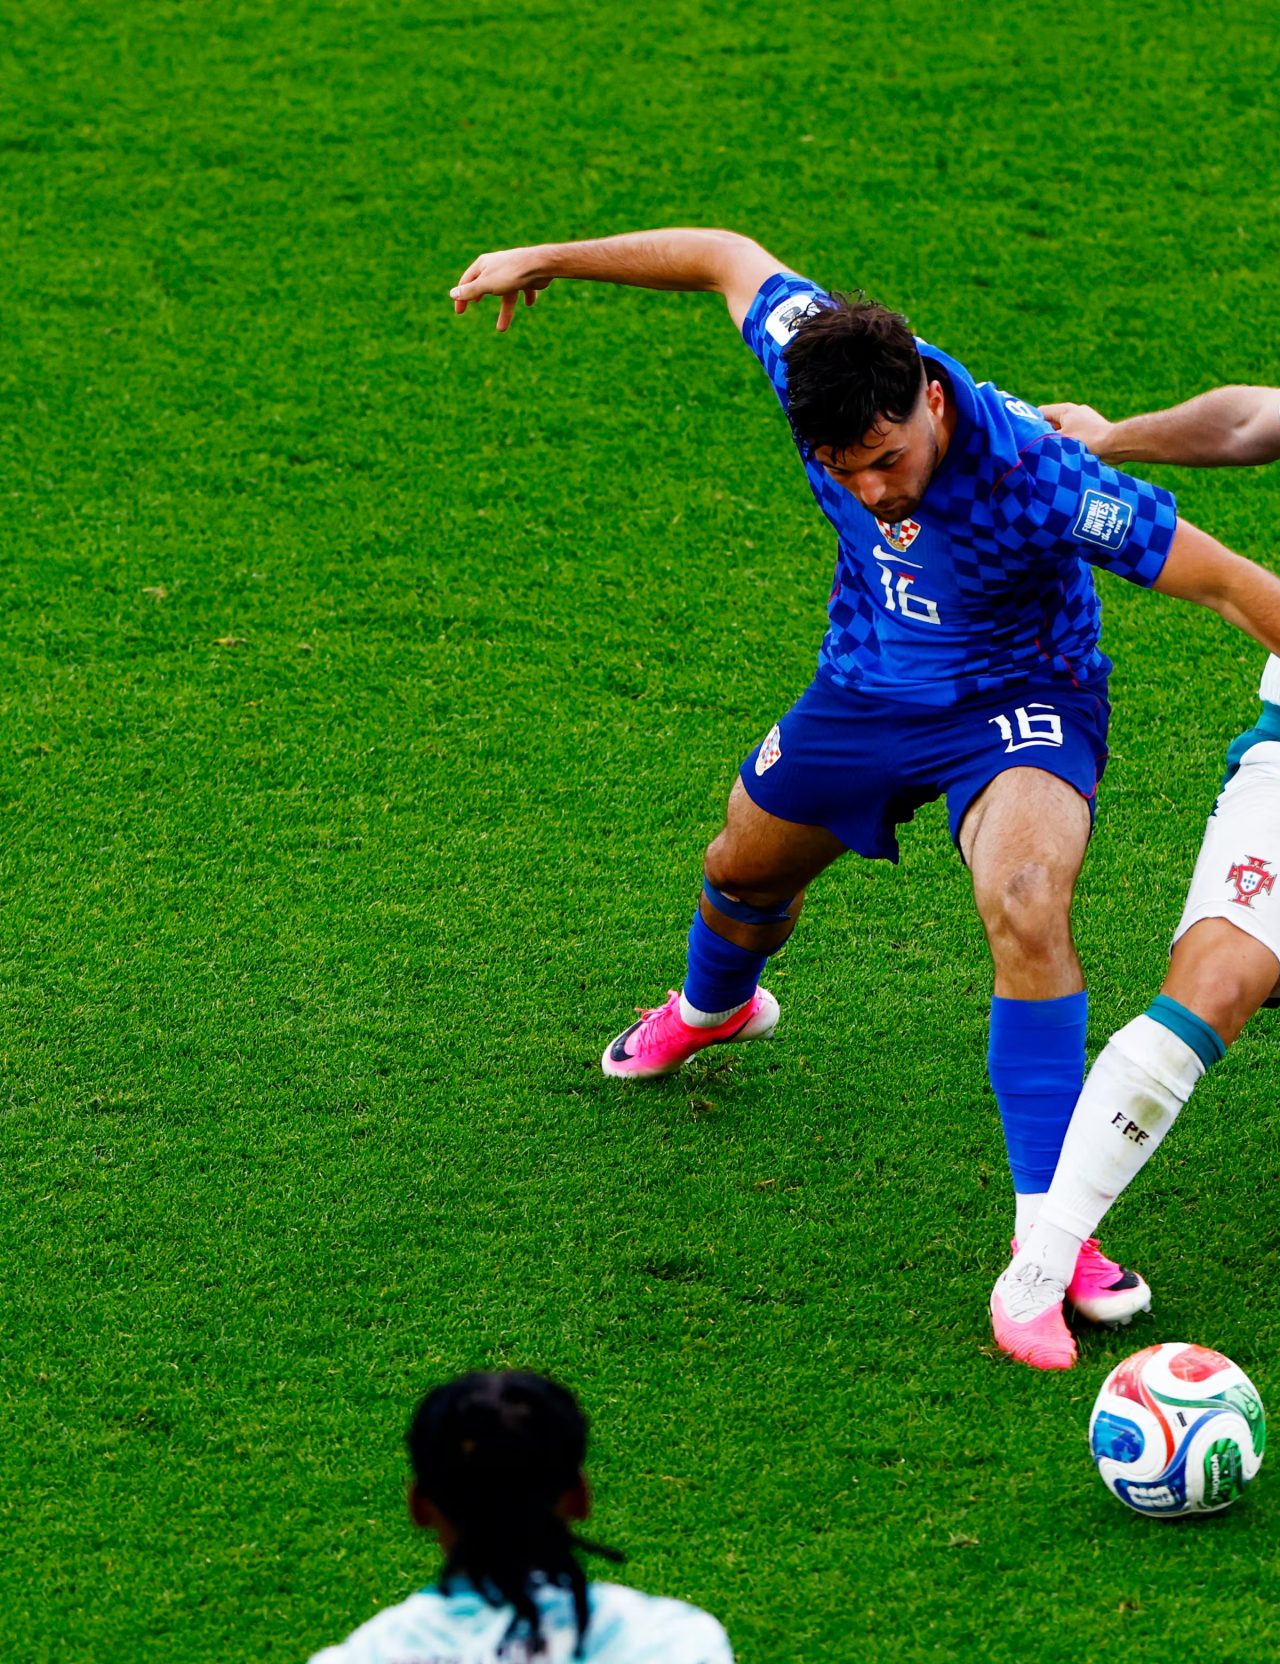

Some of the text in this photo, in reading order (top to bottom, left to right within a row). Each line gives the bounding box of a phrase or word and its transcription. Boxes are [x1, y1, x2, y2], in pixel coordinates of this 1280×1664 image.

[1081, 499, 1100, 533] FOOTBALL
[1090, 501, 1110, 536] UNITES
[876, 562, 941, 625] 16
[988, 703, 1063, 753] 16
